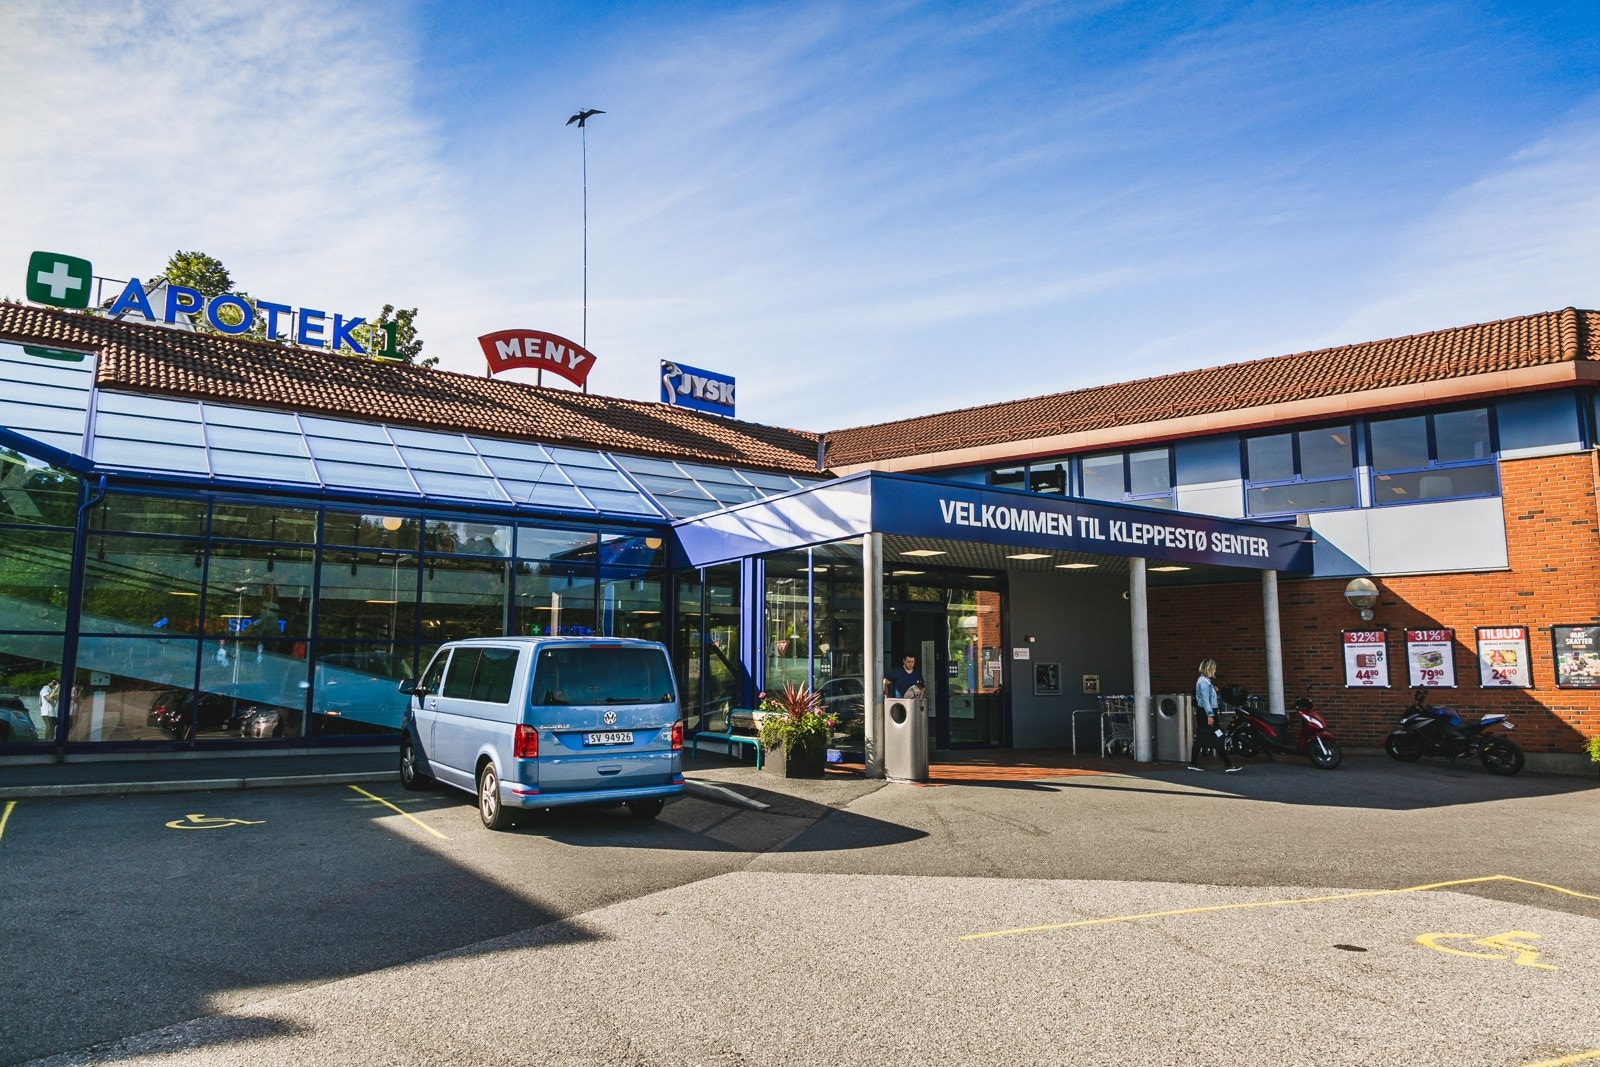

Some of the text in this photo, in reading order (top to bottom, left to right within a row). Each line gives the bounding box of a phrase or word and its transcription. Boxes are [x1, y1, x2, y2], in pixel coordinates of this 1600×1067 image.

[107, 277, 405, 361] APOTEK 1
[494, 337, 587, 370] MENY
[677, 373, 736, 406] JYSK
[939, 499, 1269, 558] VELKOMMEN TIL KLEPPESTØ SENTER
[1350, 631, 1375, 642] 32%
[1414, 630, 1441, 641] 31%
[1478, 628, 1521, 639] TILBUD
[590, 732, 631, 743] SV 94926
